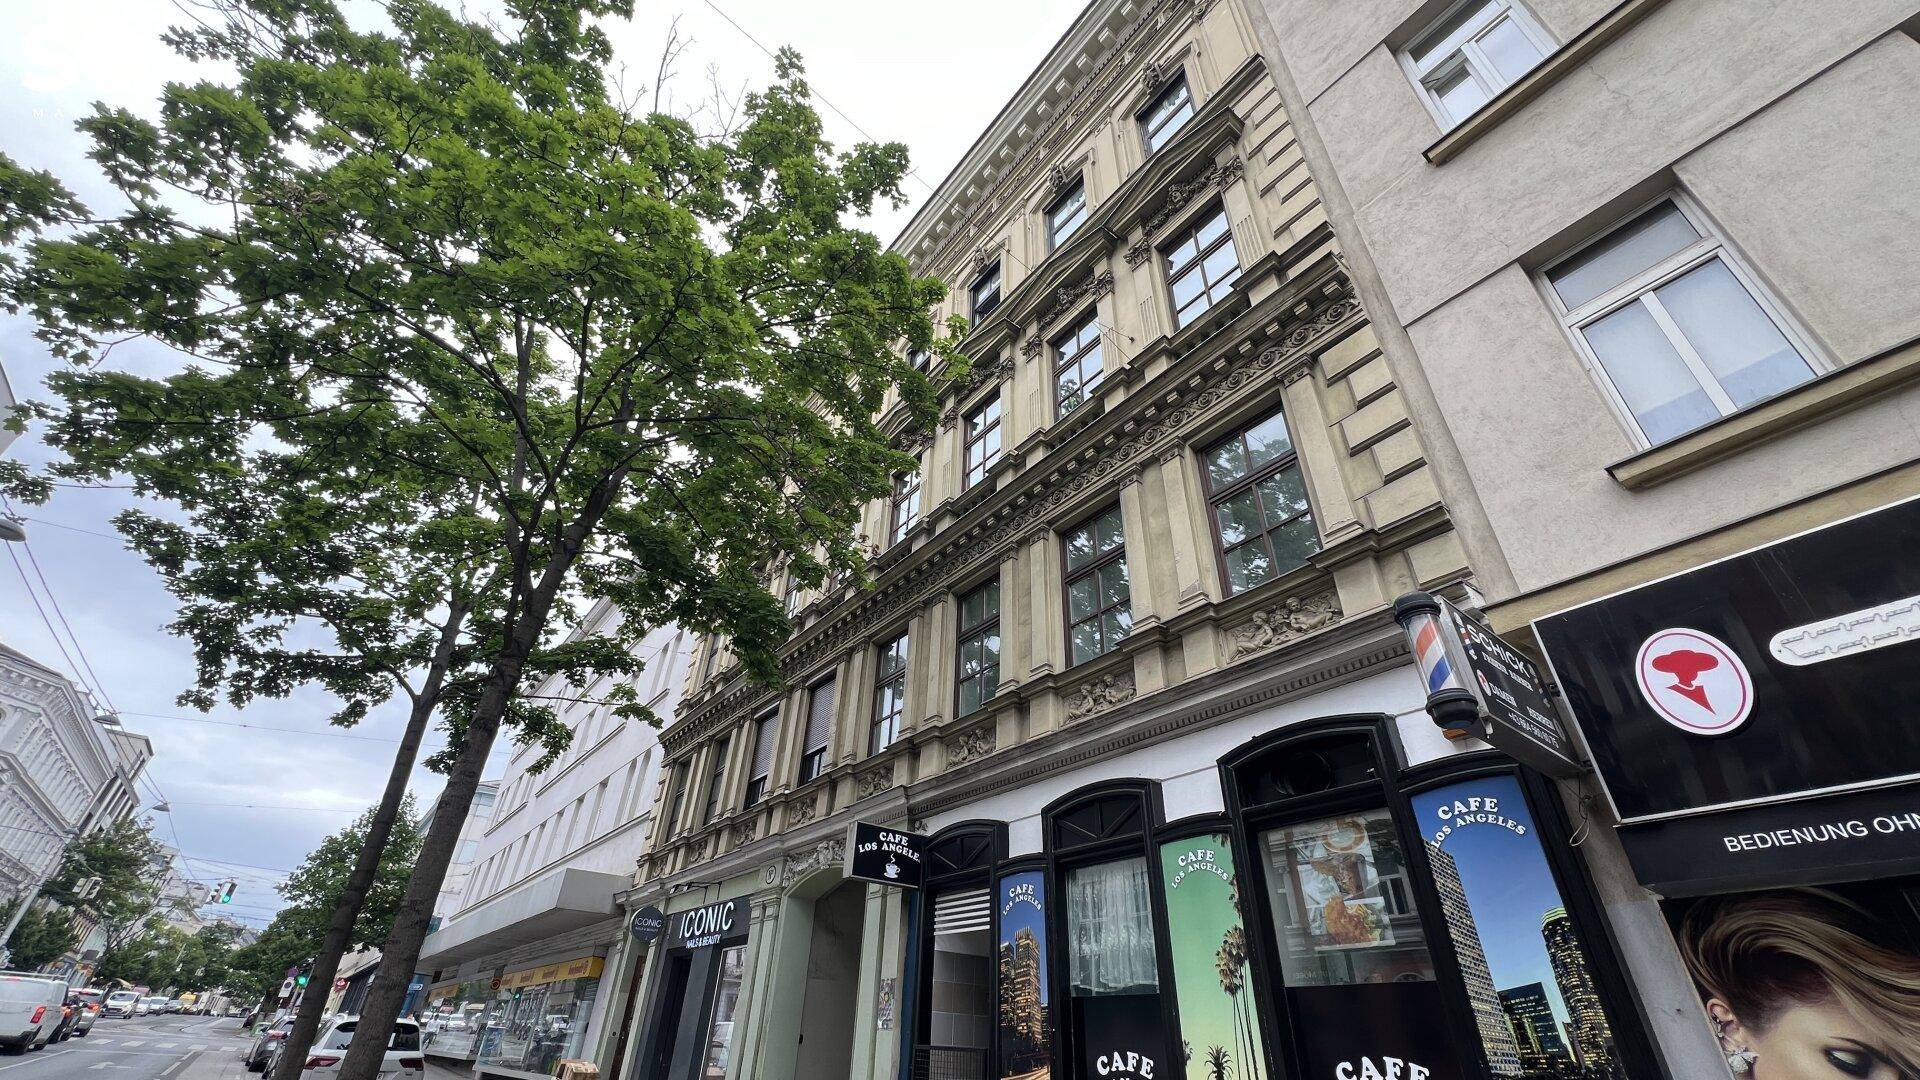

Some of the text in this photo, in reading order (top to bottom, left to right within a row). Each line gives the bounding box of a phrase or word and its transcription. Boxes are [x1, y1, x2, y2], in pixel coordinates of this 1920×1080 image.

[1466, 624, 1531, 678] SCHICK
[1437, 797, 1499, 820] CAFE
[879, 832, 909, 846] CAFE
[1430, 813, 1527, 849] LOS ANGELES
[1723, 820, 1869, 852] BEDIENUNG
[858, 842, 920, 864] LOS ANGELE
[1178, 850, 1215, 867] CAFE
[1171, 862, 1229, 889] LOS ANGELES
[1009, 883, 1035, 898] CAFE
[1003, 894, 1042, 916] LOS ANGELES
[634, 917, 662, 928] ICONIC
[679, 901, 735, 939] ICONIC
[1096, 1051, 1154, 1080] CAFE
